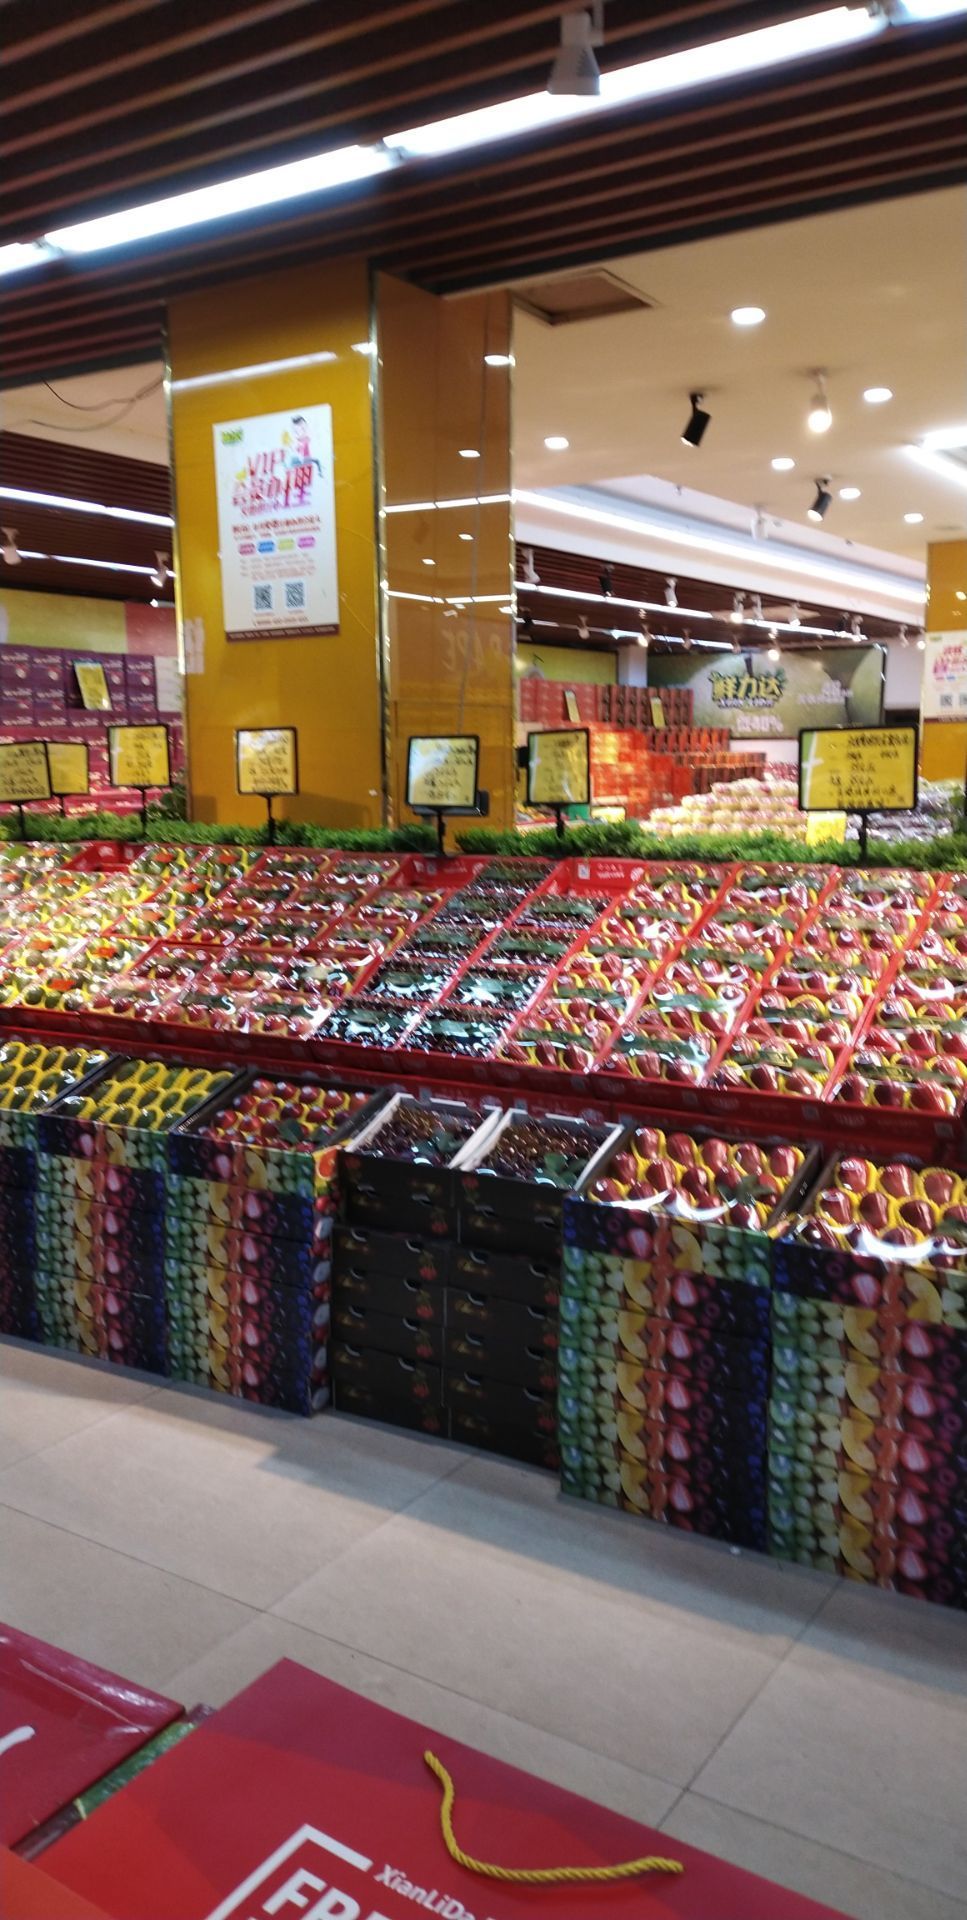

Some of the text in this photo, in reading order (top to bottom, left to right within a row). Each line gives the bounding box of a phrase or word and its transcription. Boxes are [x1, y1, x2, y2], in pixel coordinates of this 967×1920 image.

[248, 449, 285, 477] VIP
[712, 675, 782, 699] 鲜力达
[262, 1867, 396, 1920] FR
